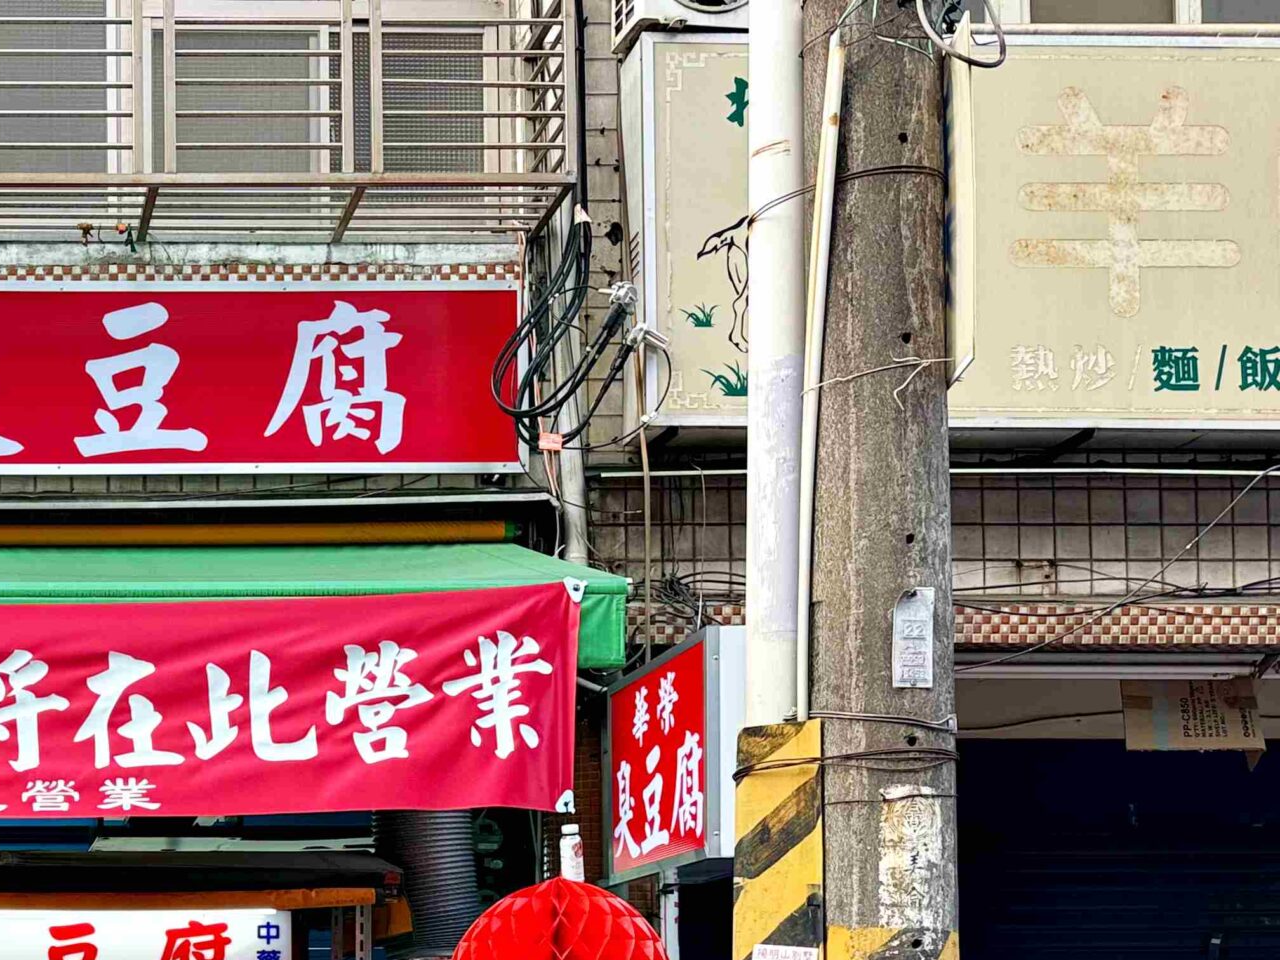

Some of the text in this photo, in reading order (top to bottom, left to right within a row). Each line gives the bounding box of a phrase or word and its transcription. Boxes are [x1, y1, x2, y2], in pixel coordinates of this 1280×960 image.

[632, 671, 679, 747] 華榮
[613, 730, 704, 859] 臭豆腐
